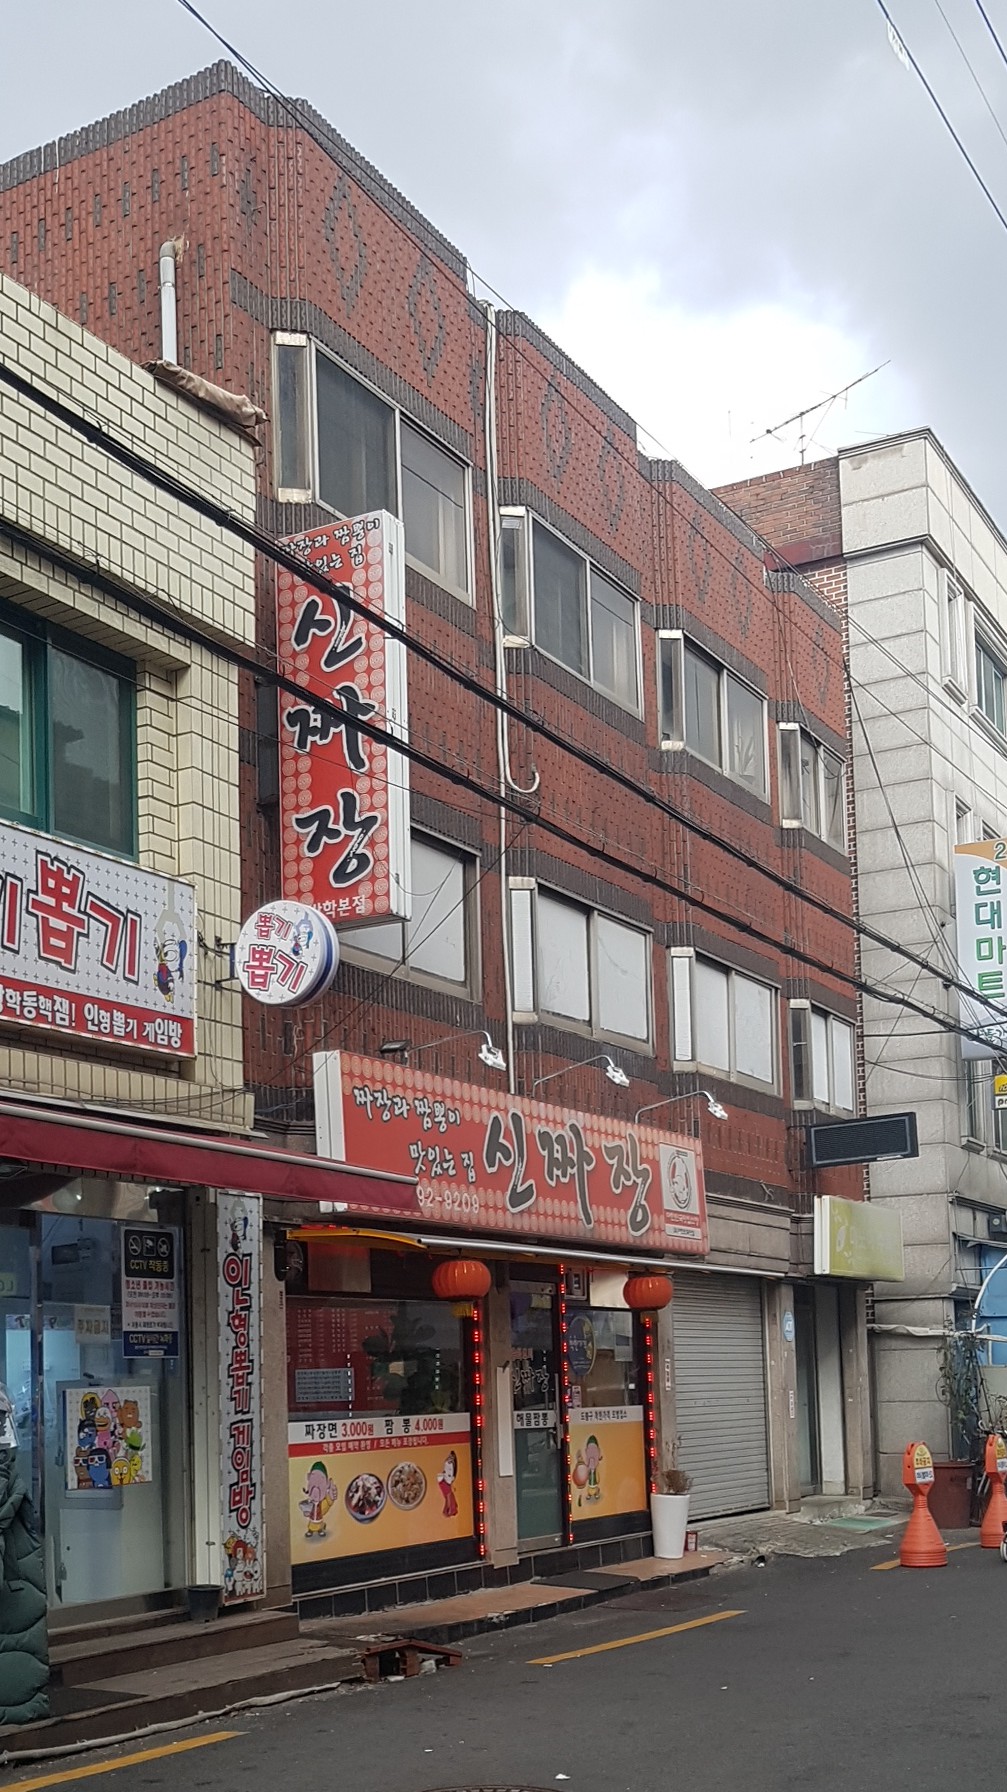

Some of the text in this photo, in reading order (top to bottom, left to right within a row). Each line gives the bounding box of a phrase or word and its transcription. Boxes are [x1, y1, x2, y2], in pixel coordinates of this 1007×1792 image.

[333, 518, 380, 546] 짬뽕이
[306, 553, 344, 575] 있는
[348, 544, 365, 567] 집
[283, 581, 381, 889] 신짜장
[255, 911, 294, 941] 뽑기
[972, 865, 1007, 1000] 현대마트
[243, 943, 309, 995] 뽑기
[83, 1002, 138, 1040] 인형뽑기
[142, 1017, 183, 1049] 게임방
[413, 1096, 461, 1134] 짬뽕이
[408, 1138, 477, 1184] 맛있는 집
[483, 1108, 652, 1237] 신짜장
[130, 1259, 148, 1270] CCTV
[222, 1252, 255, 1415] 인형뽑기
[304, 1421, 338, 1440] 짜장면
[516, 1412, 549, 1427] 해물짬뽕
[229, 1417, 257, 1529] 게임방
